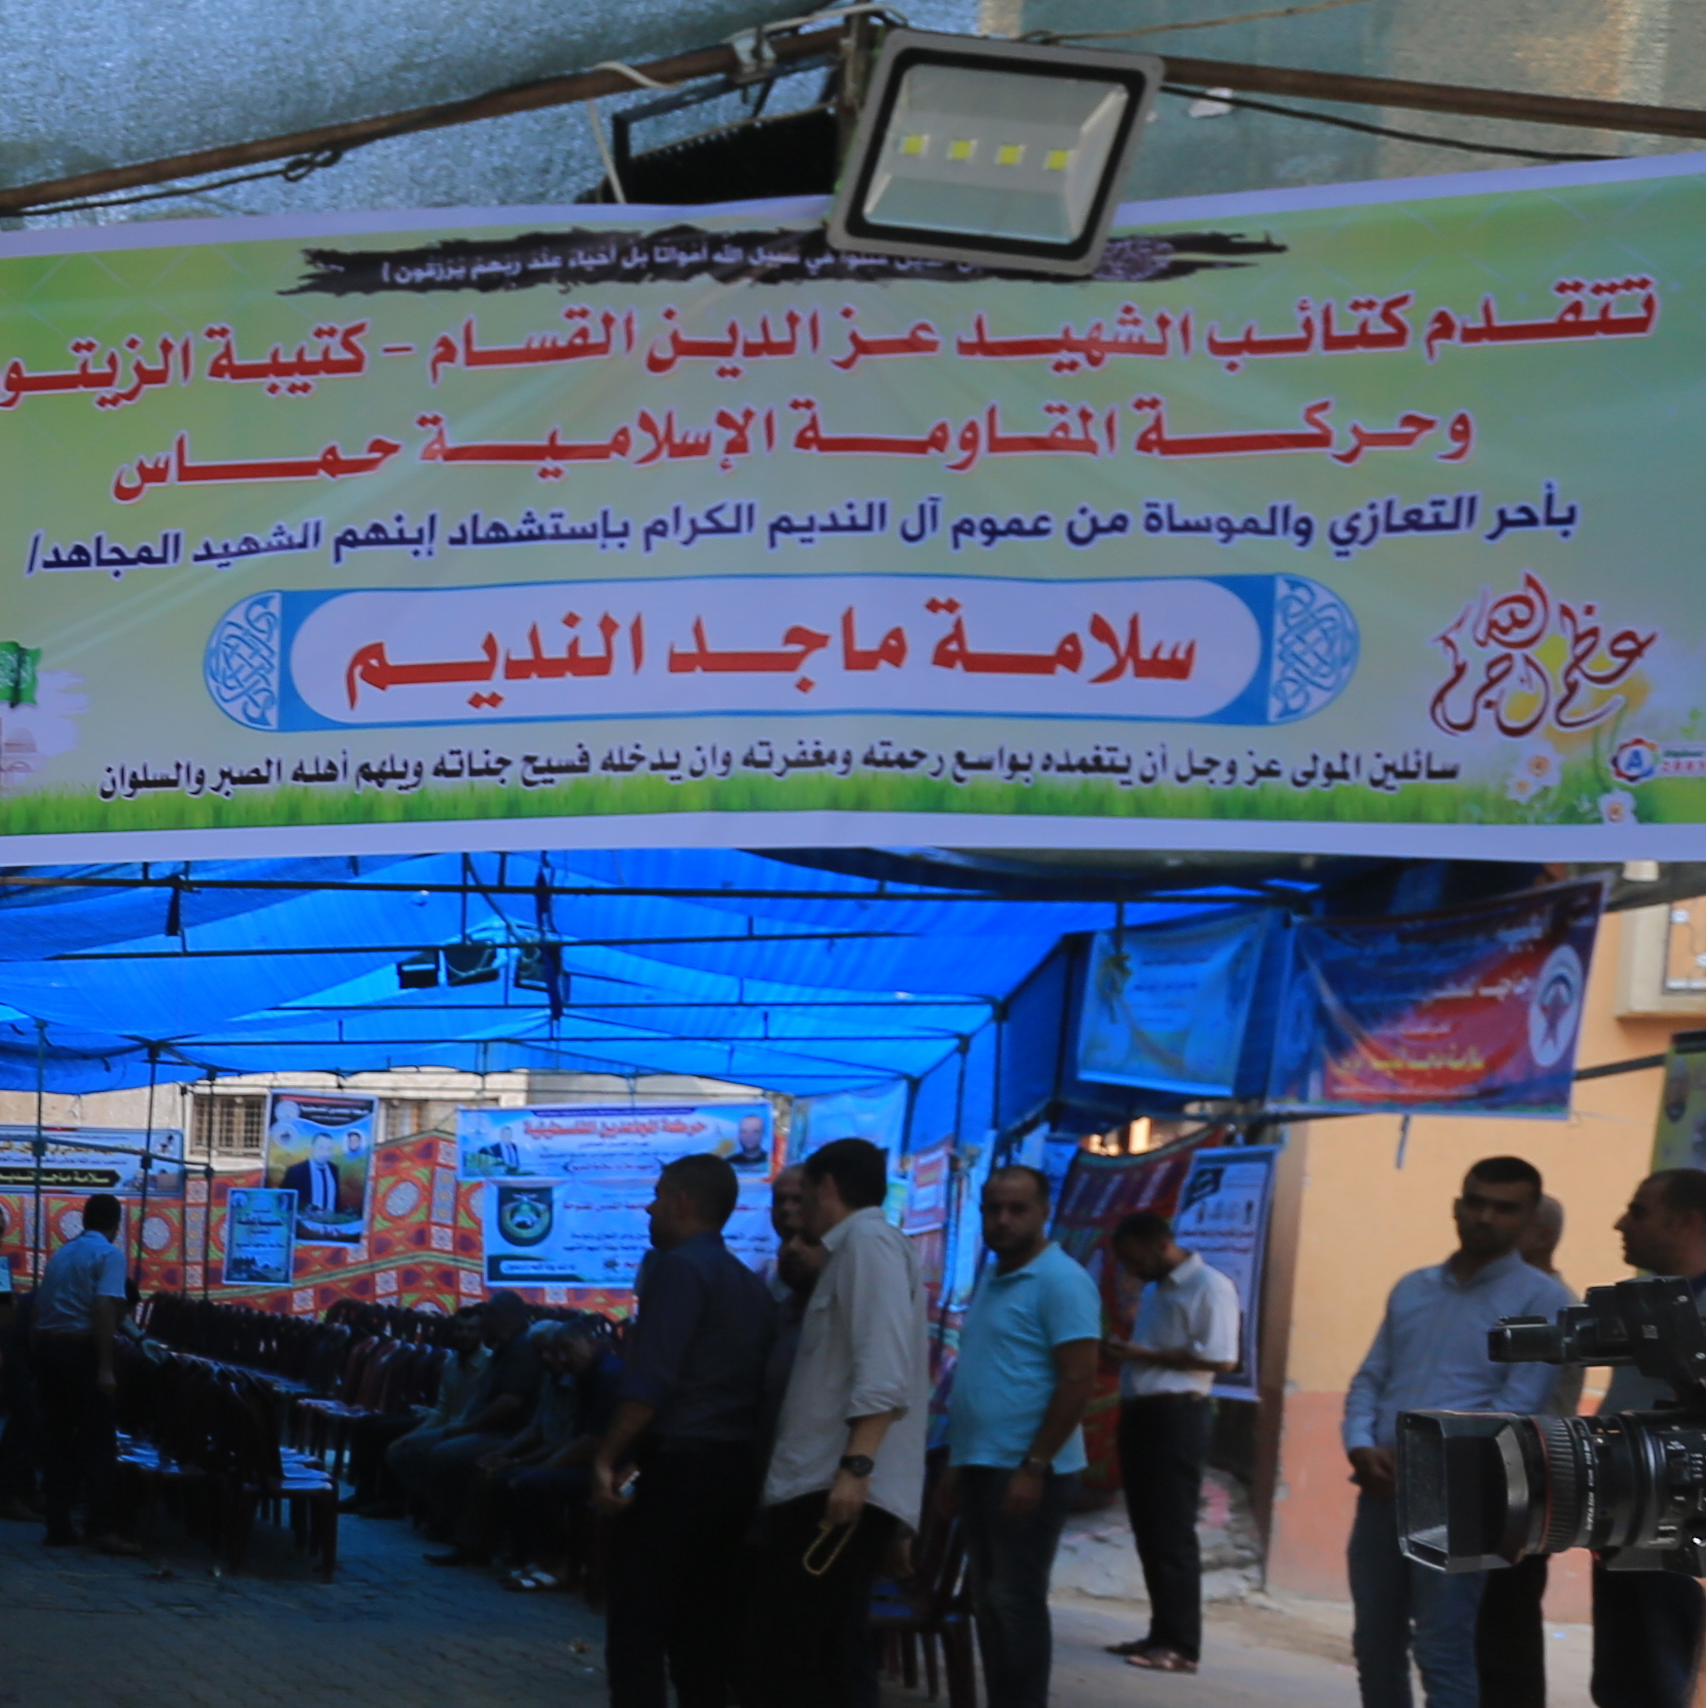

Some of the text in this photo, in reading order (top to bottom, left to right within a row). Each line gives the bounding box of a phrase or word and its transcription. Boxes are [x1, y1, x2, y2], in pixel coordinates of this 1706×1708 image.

[646, 305, 819, 379] الدين
[830, 304, 940, 372] عز
[957, 302, 1193, 375] الشهيد
[1207, 292, 1414, 374] كتائب
[1424, 275, 1657, 363] تتقدم
[205, 319, 370, 397] كتيبة
[428, 305, 635, 386] القسام
[112, 396, 1474, 501] وحركة المقاومة الإسلامية حماس
[447, 507, 631, 553] بإستشهاد
[643, 501, 756, 554] الكرام
[768, 499, 887, 550] النديم
[900, 496, 942, 545] آل
[950, 507, 1054, 552] عموم
[1066, 505, 1130, 550] من
[1143, 501, 1314, 549] والموساة
[1329, 492, 1480, 559] التعازي
[1484, 480, 1578, 541] بأحر
[191, 518, 324, 570] الشهيد
[332, 511, 438, 565] إبنهم
[344, 595, 1197, 711] سلامة ماجد النديم
[98, 757, 207, 801] والسلوان
[212, 755, 283, 801] الصبر
[290, 749, 350, 786] أهله
[355, 753, 425, 795] ويلهم
[431, 747, 514, 787] جناته
[519, 742, 592, 790] فسيح
[599, 740, 683, 785] يدخله
[741, 739, 854, 779] ومغفرته
[861, 740, 946, 778] رحمته
[949, 743, 1035, 785] بواسع
[1039, 746, 1135, 787] يتغمده
[1177, 749, 1241, 788] وجل
[1244, 749, 1283, 785] عز
[1292, 750, 1364, 788] المولى
[1369, 747, 1461, 792] سائلين
